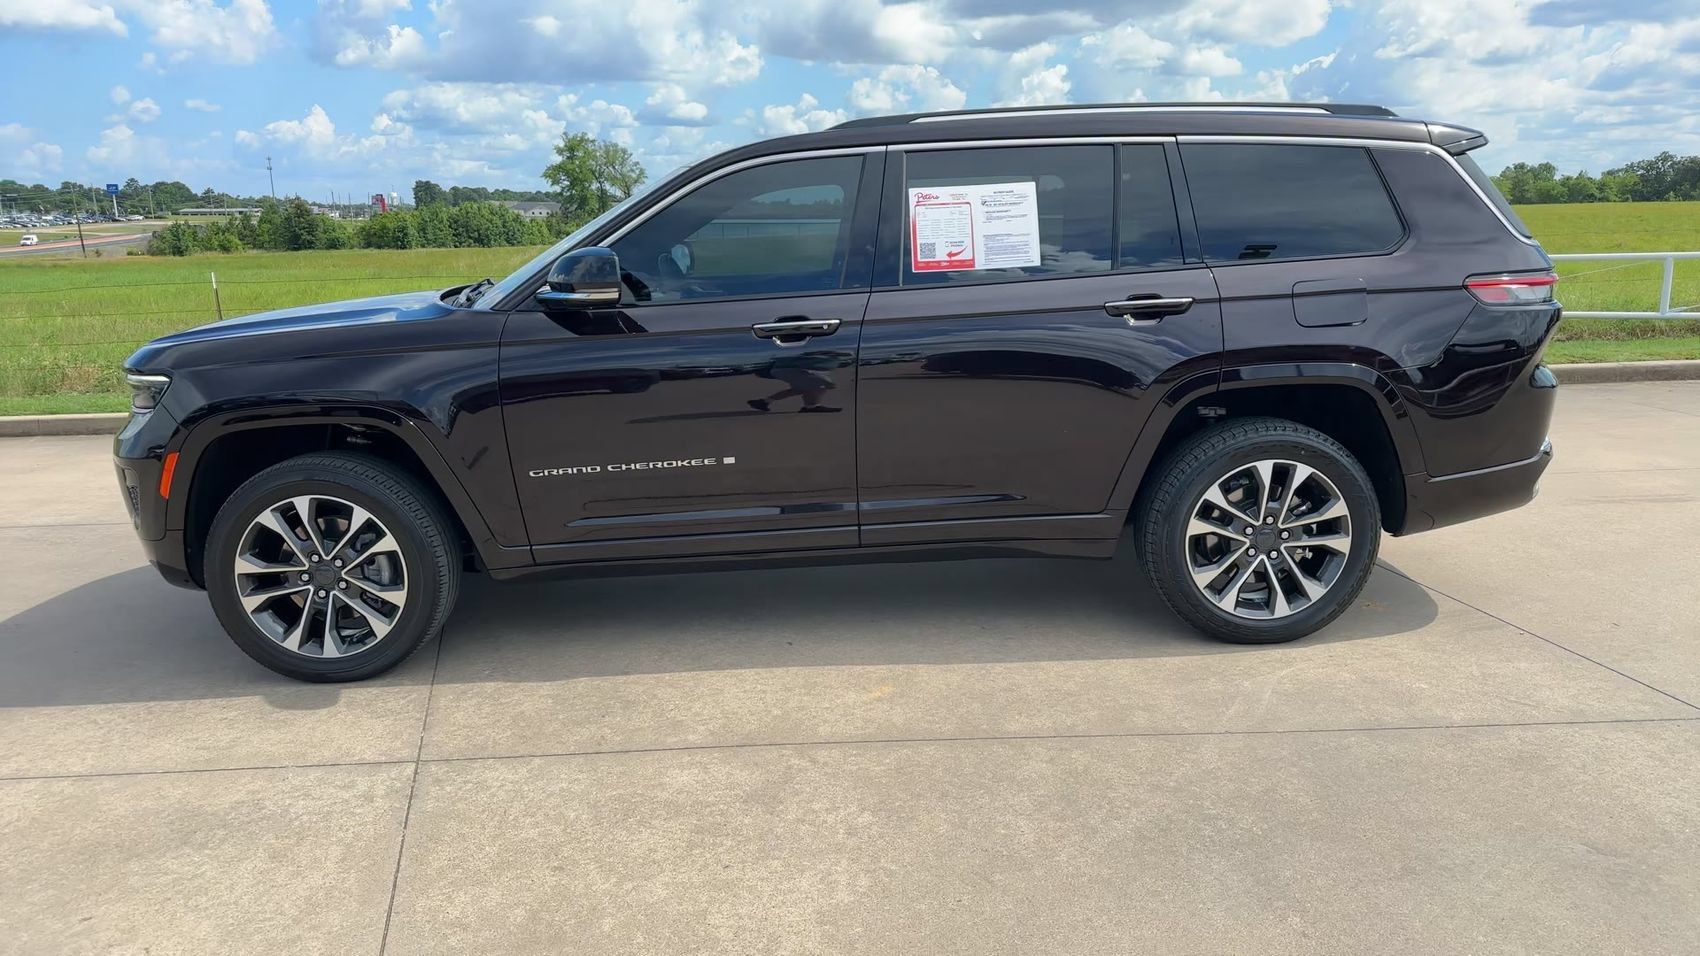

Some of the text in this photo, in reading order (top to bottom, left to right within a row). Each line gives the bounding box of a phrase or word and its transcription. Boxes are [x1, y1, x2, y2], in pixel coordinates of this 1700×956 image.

[914, 192, 940, 203] Peters
[529, 458, 718, 477] GRAND CHEROKEE
